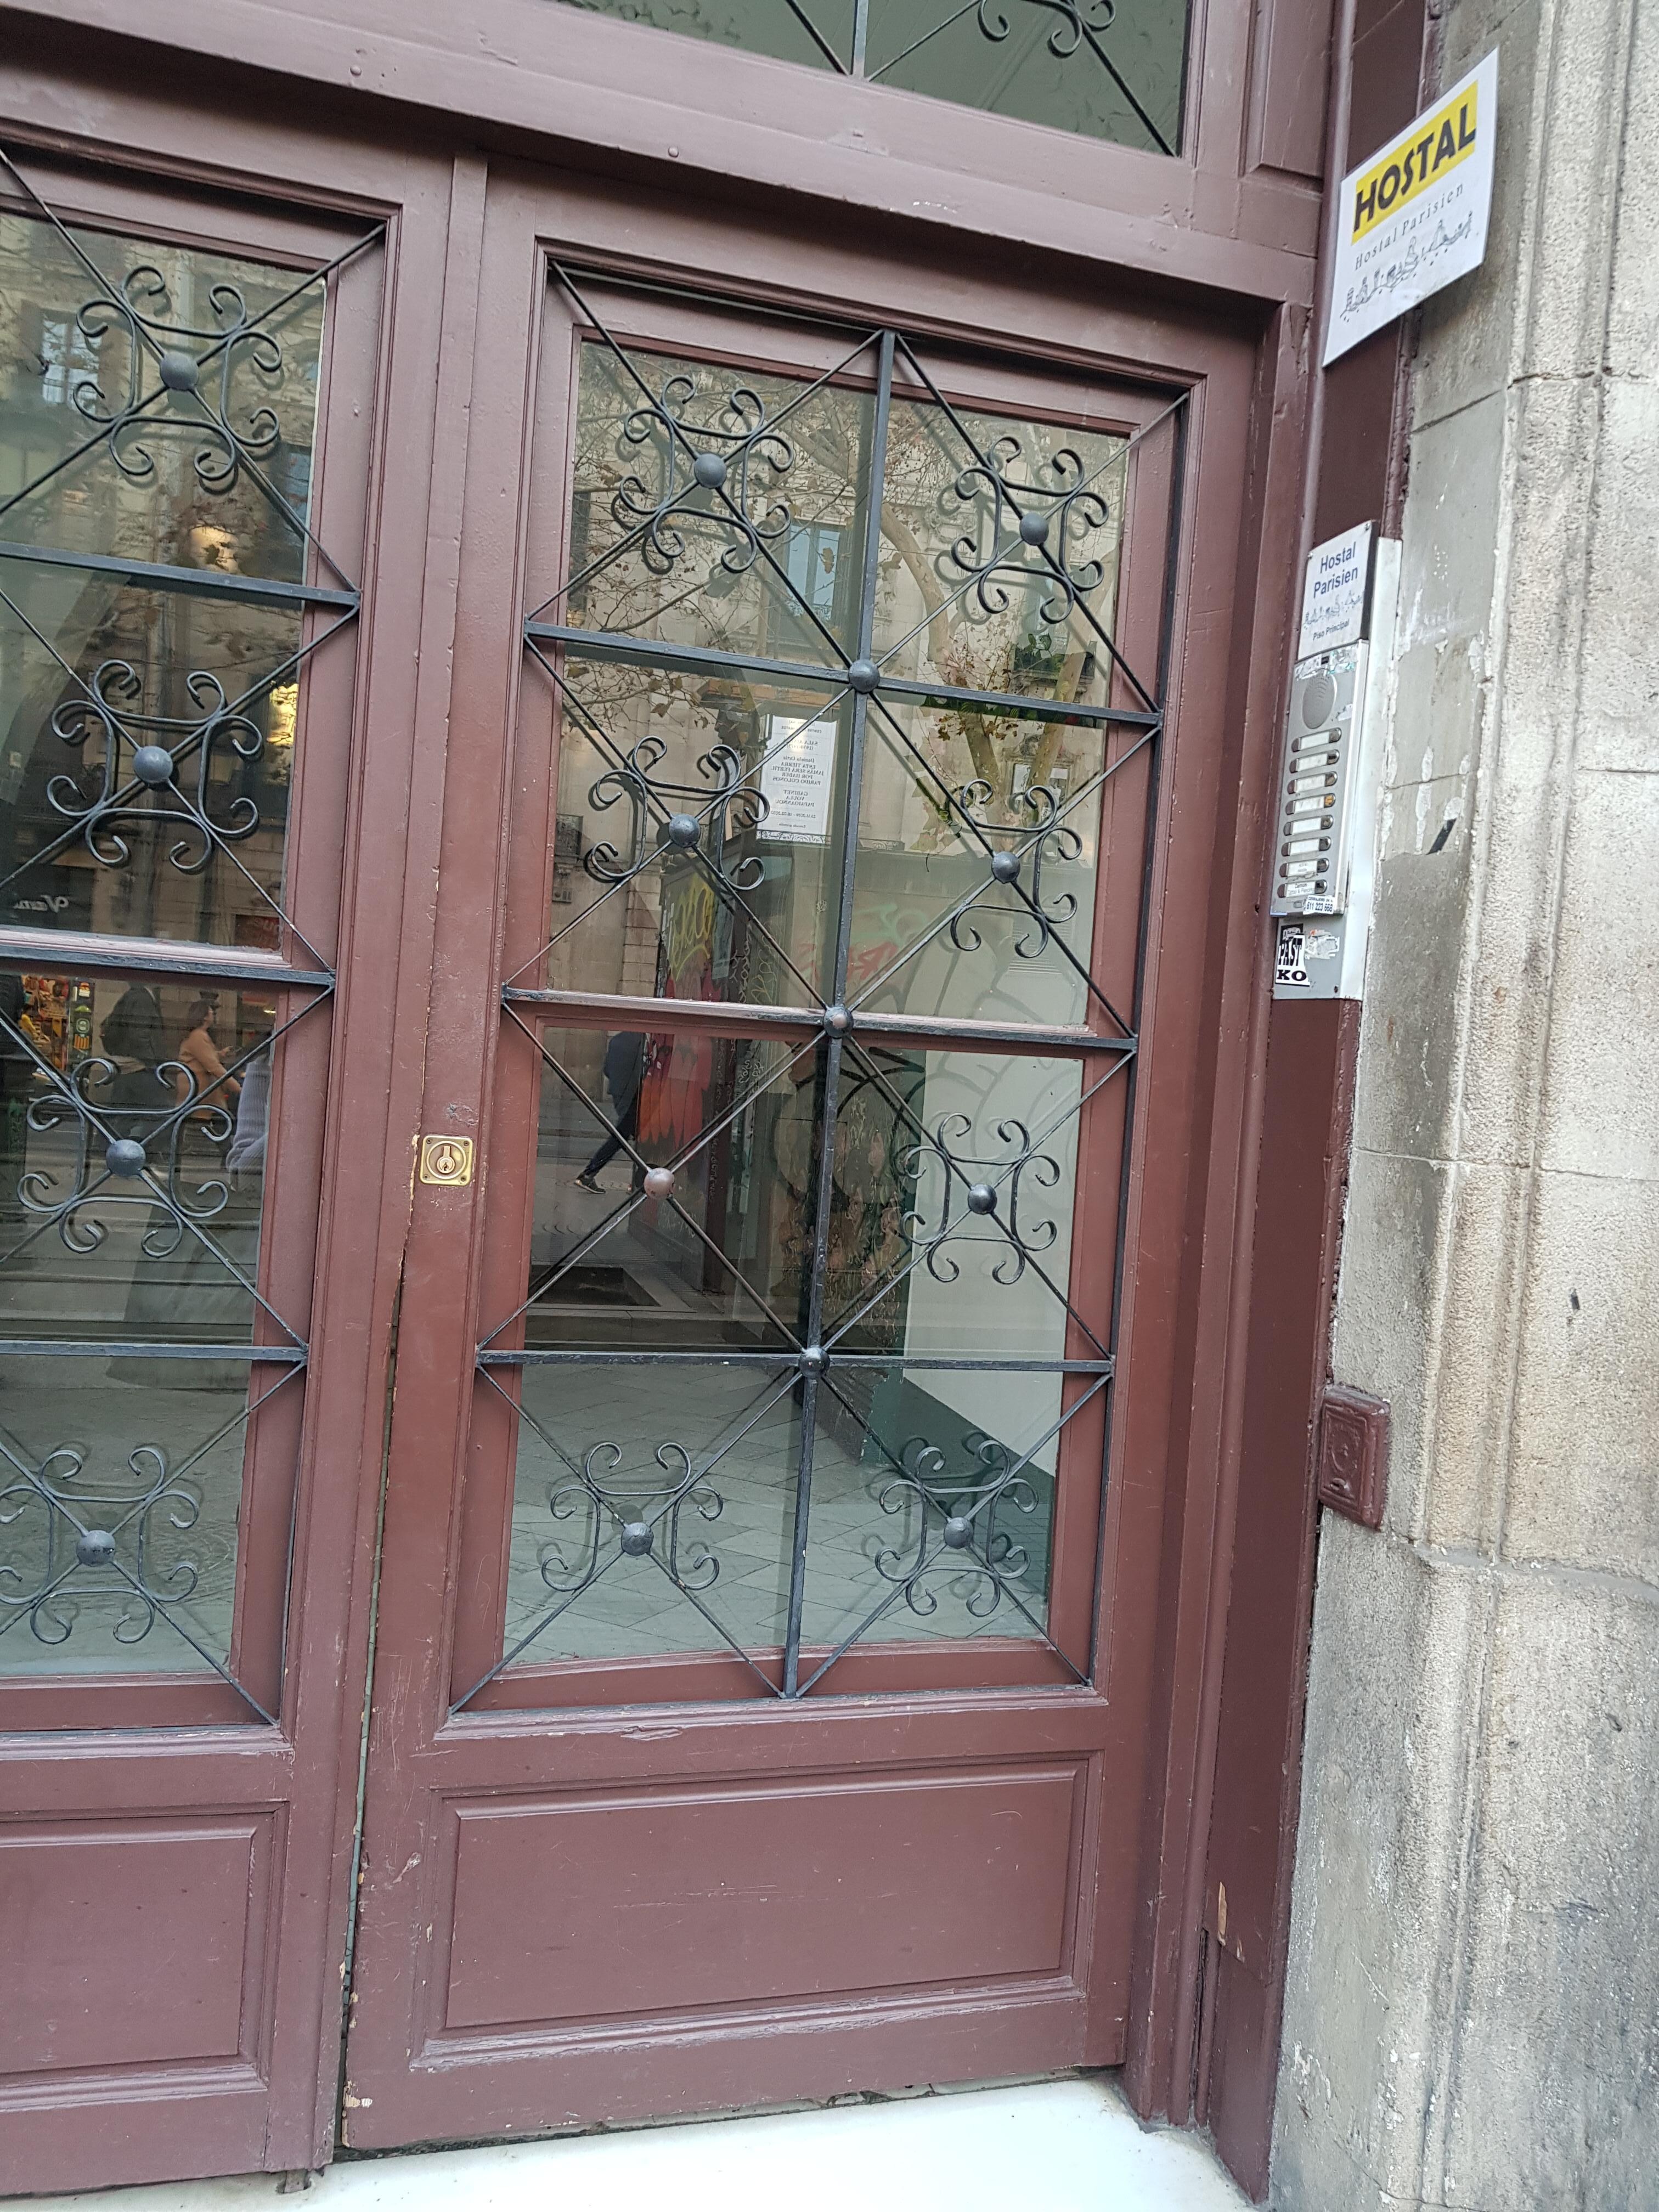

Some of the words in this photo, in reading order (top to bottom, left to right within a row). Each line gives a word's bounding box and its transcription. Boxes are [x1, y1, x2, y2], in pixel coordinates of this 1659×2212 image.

[1353, 103, 1476, 233] HOSTAL
[1355, 228, 1397, 270] Hostal
[1401, 184, 1463, 236] Parisien
[1320, 541, 1356, 574] Hostal
[1313, 567, 1358, 599] Parisien
[1313, 631, 1324, 641] Piso
[1315, 902, 1323, 911] 223
[1277, 969, 1307, 981] KO
